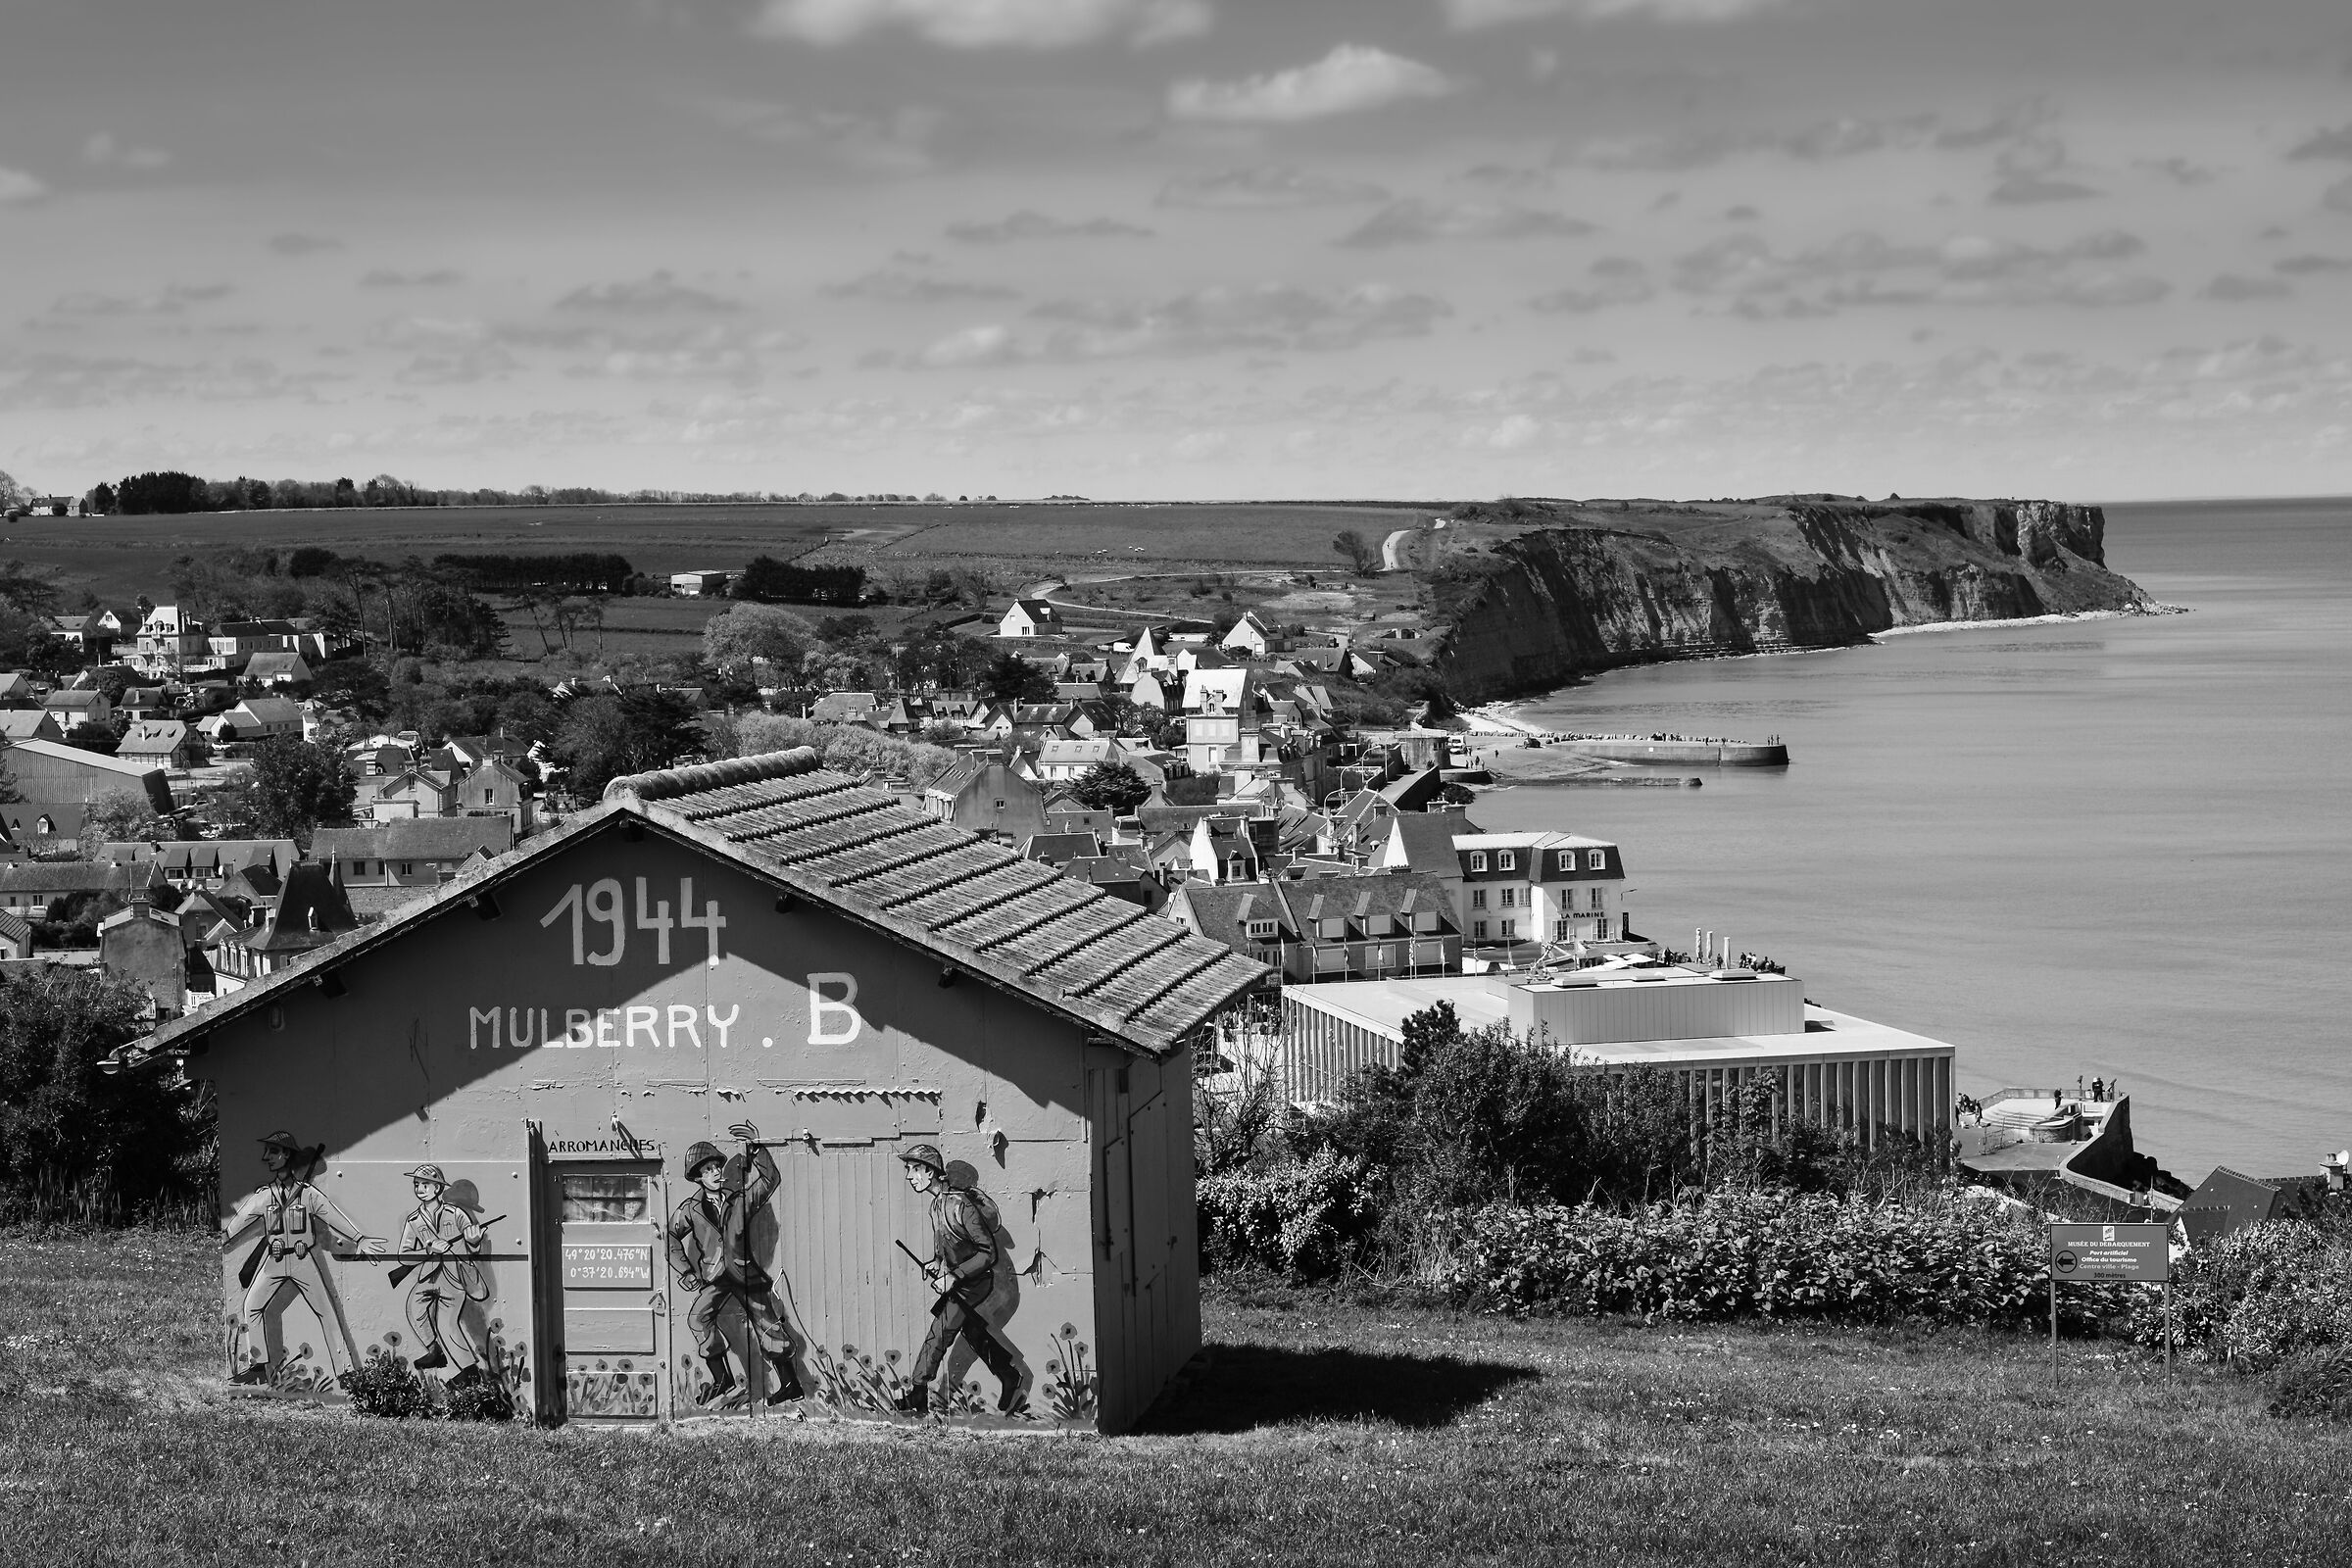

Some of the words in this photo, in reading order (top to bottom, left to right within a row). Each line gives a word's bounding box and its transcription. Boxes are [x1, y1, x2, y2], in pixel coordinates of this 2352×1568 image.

[540, 877, 727, 966] 1944
[469, 1004, 740, 1049] MULBERRY
[807, 972, 862, 1046] B
[548, 1139, 656, 1152] ARROMANCHES
